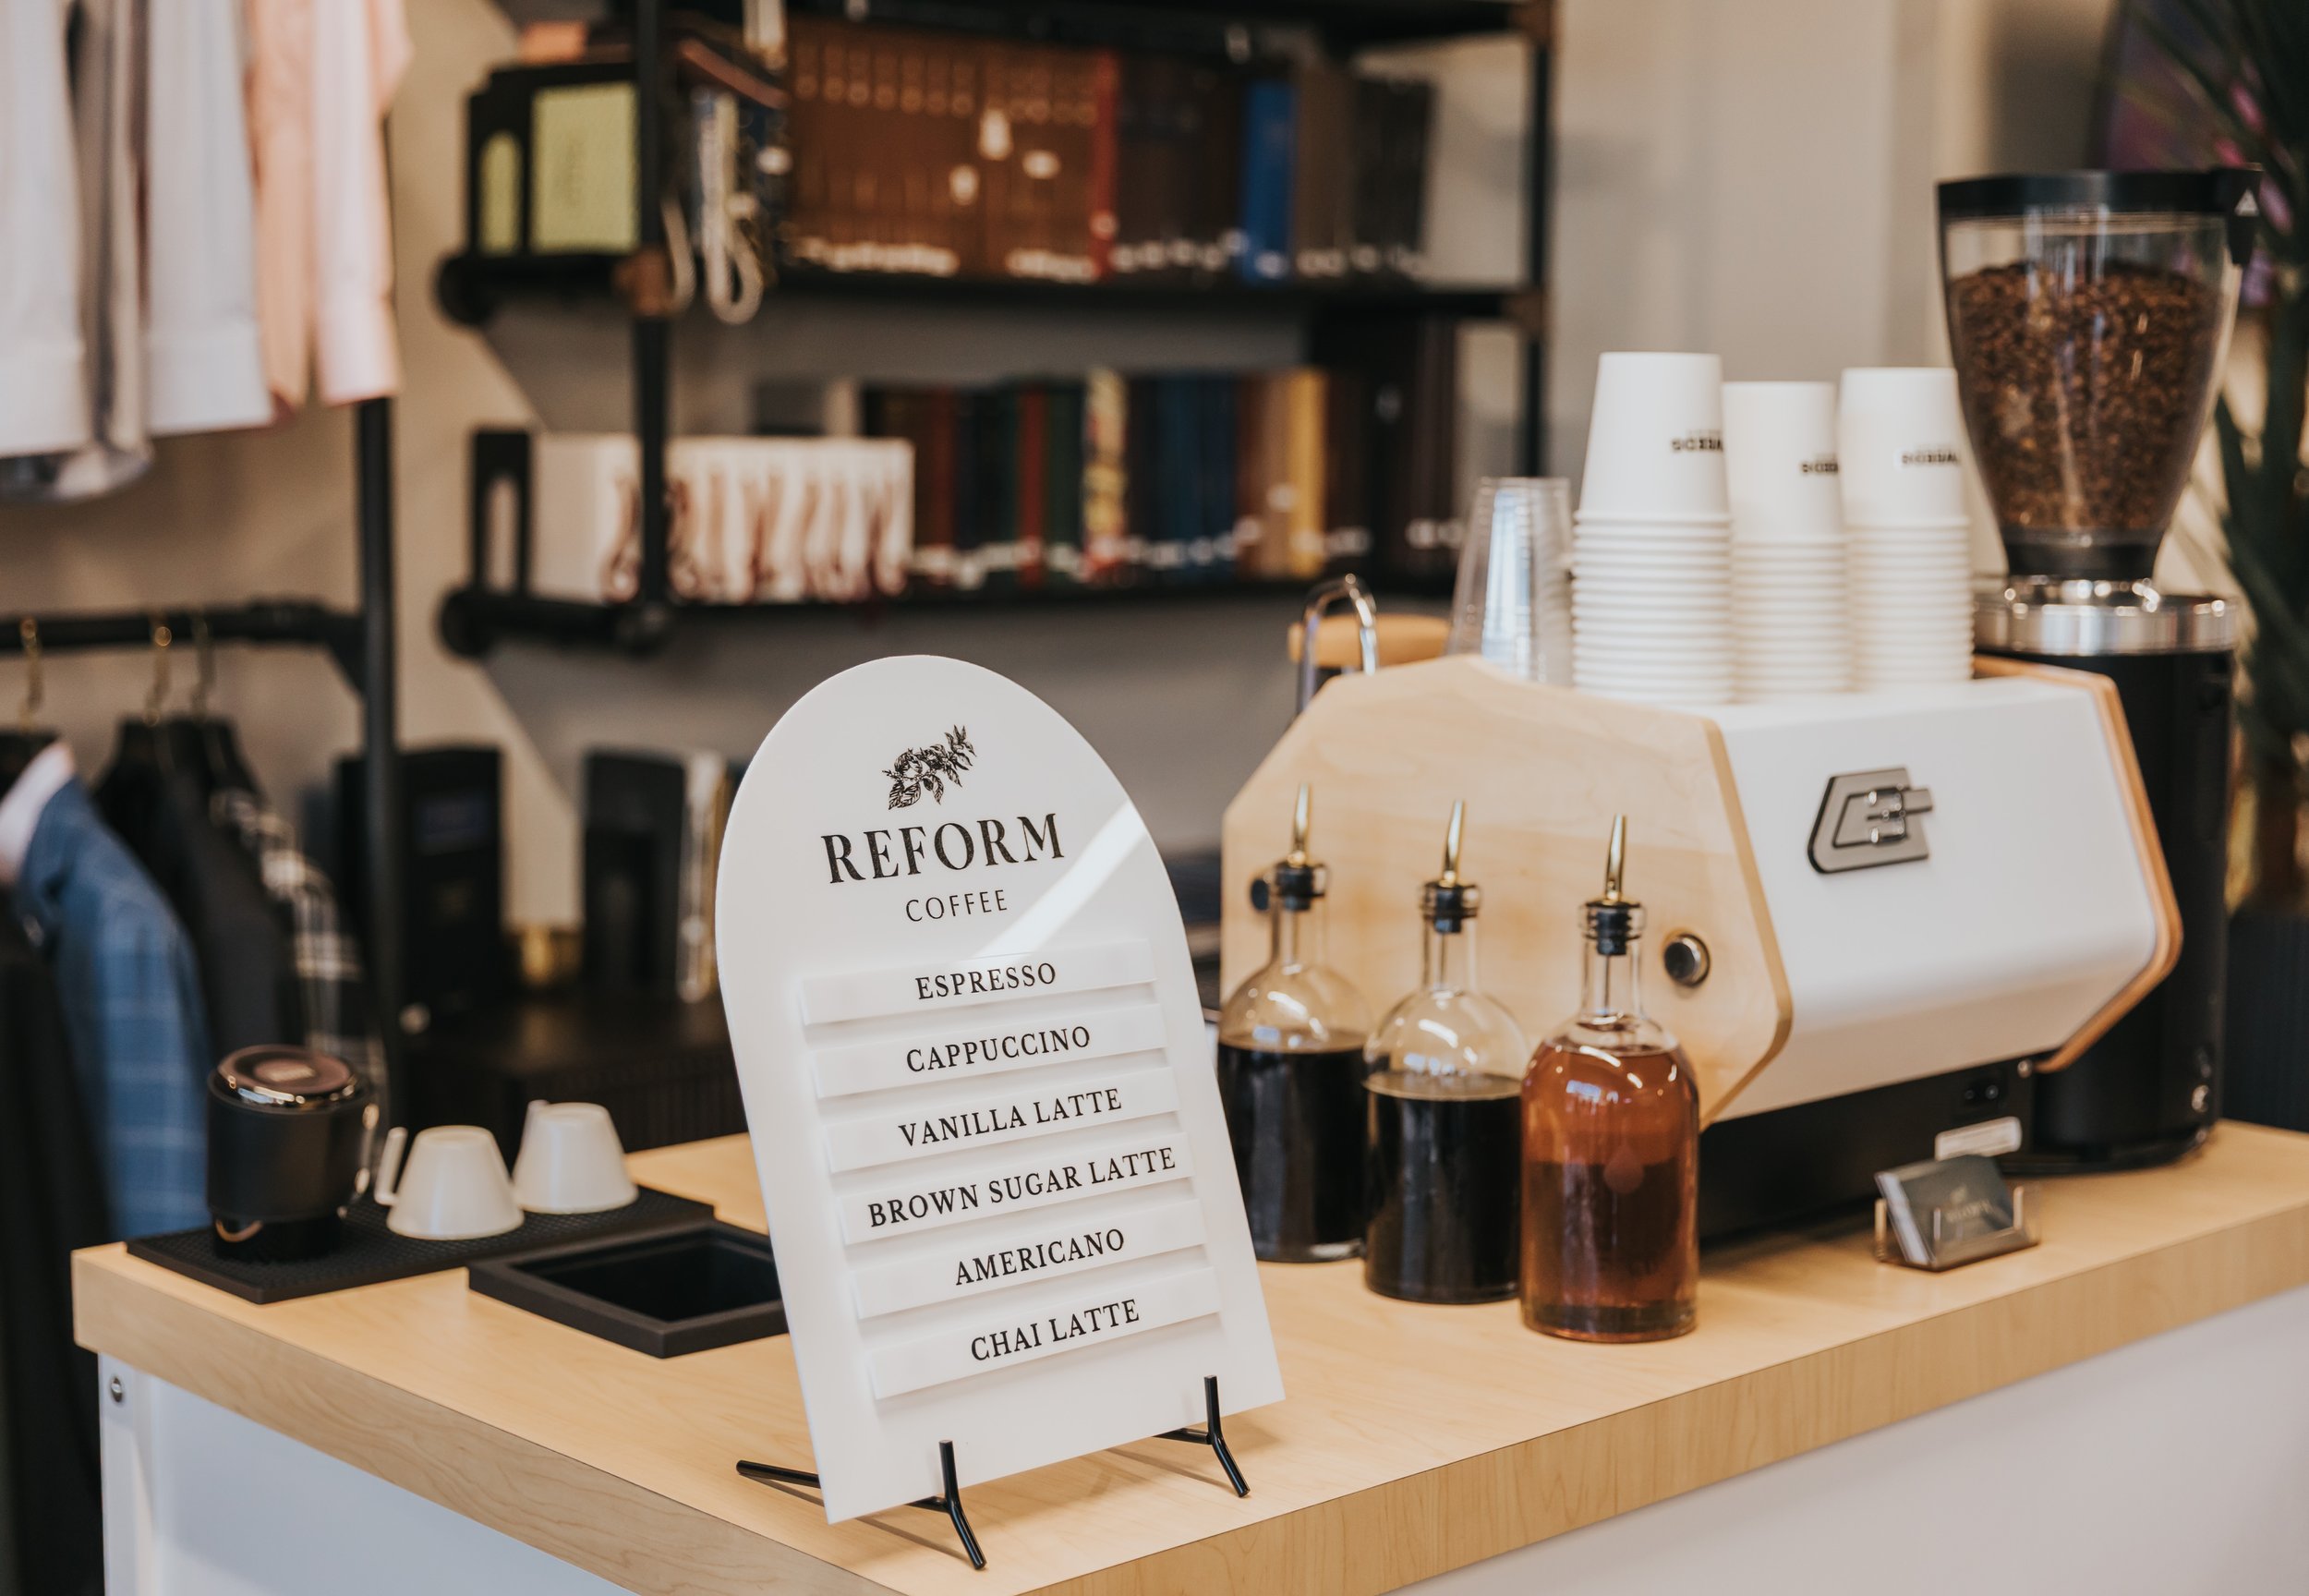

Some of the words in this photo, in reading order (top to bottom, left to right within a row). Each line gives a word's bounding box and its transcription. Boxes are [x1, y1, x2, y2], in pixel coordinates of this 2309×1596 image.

[821, 814, 1064, 883] REFORM
[906, 890, 1007, 922] COFFEE
[914, 963, 1056, 999] ESPRESSO
[906, 1026, 1090, 1071] CAPPUCCINO
[898, 1106, 1027, 1146] VANILLA
[1033, 1088, 1122, 1122] LATTE
[868, 1185, 979, 1227] BROWN
[989, 1167, 1082, 1203] SUGAR
[1089, 1147, 1176, 1184] LATTE
[955, 1228, 1125, 1286] AMERICANO
[971, 1323, 1043, 1361] CHAI
[1049, 1299, 1140, 1342] LATTE
